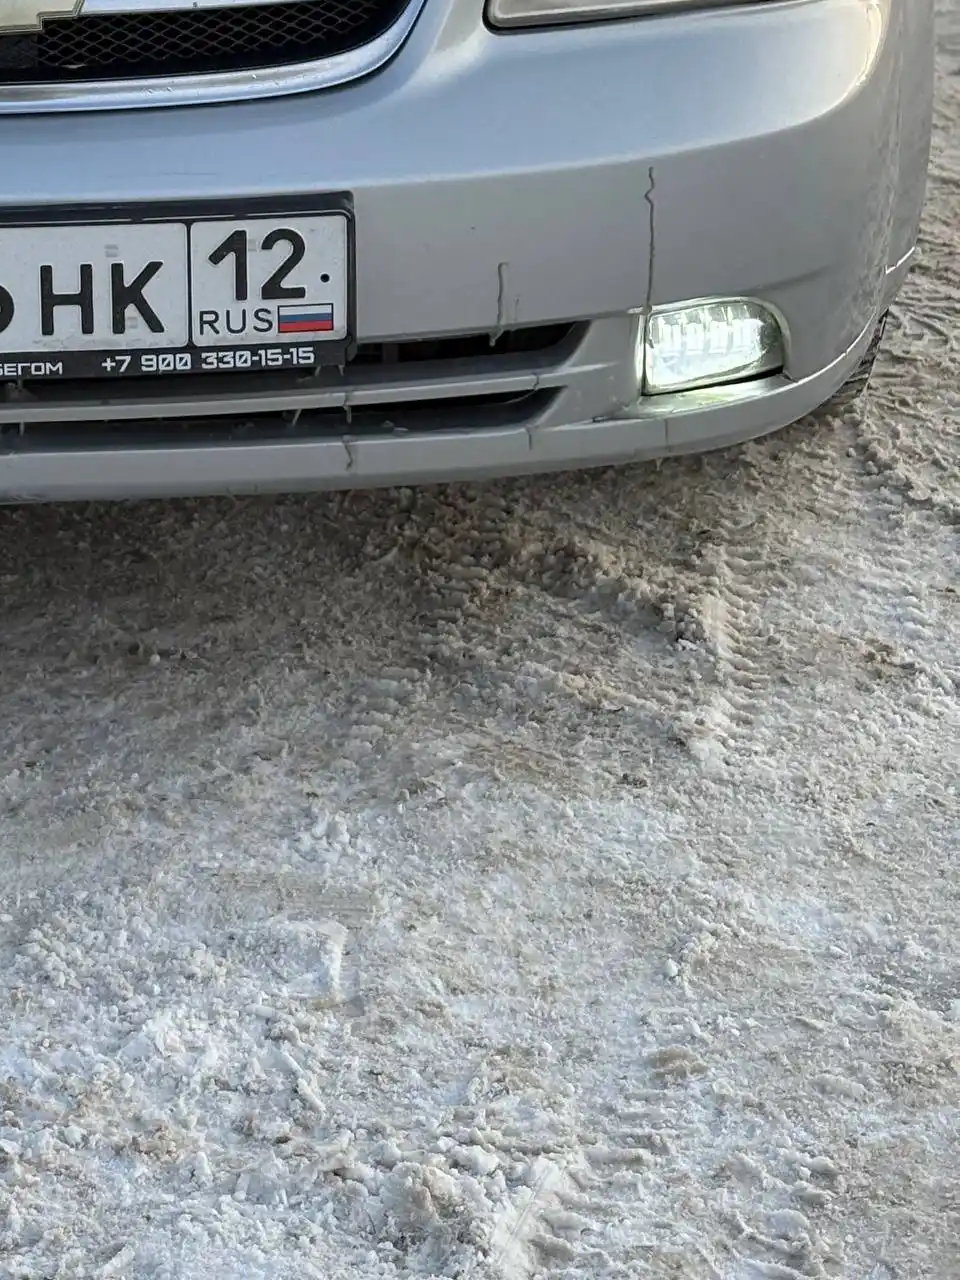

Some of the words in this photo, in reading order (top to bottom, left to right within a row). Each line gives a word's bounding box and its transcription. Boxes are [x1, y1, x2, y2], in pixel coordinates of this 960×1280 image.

[208, 228, 306, 301] 12
[199, 308, 273, 335] RUS
[101, 356, 131, 373] +7
[141, 353, 192, 371] 900
[201, 347, 316, 368] 330-15-15
